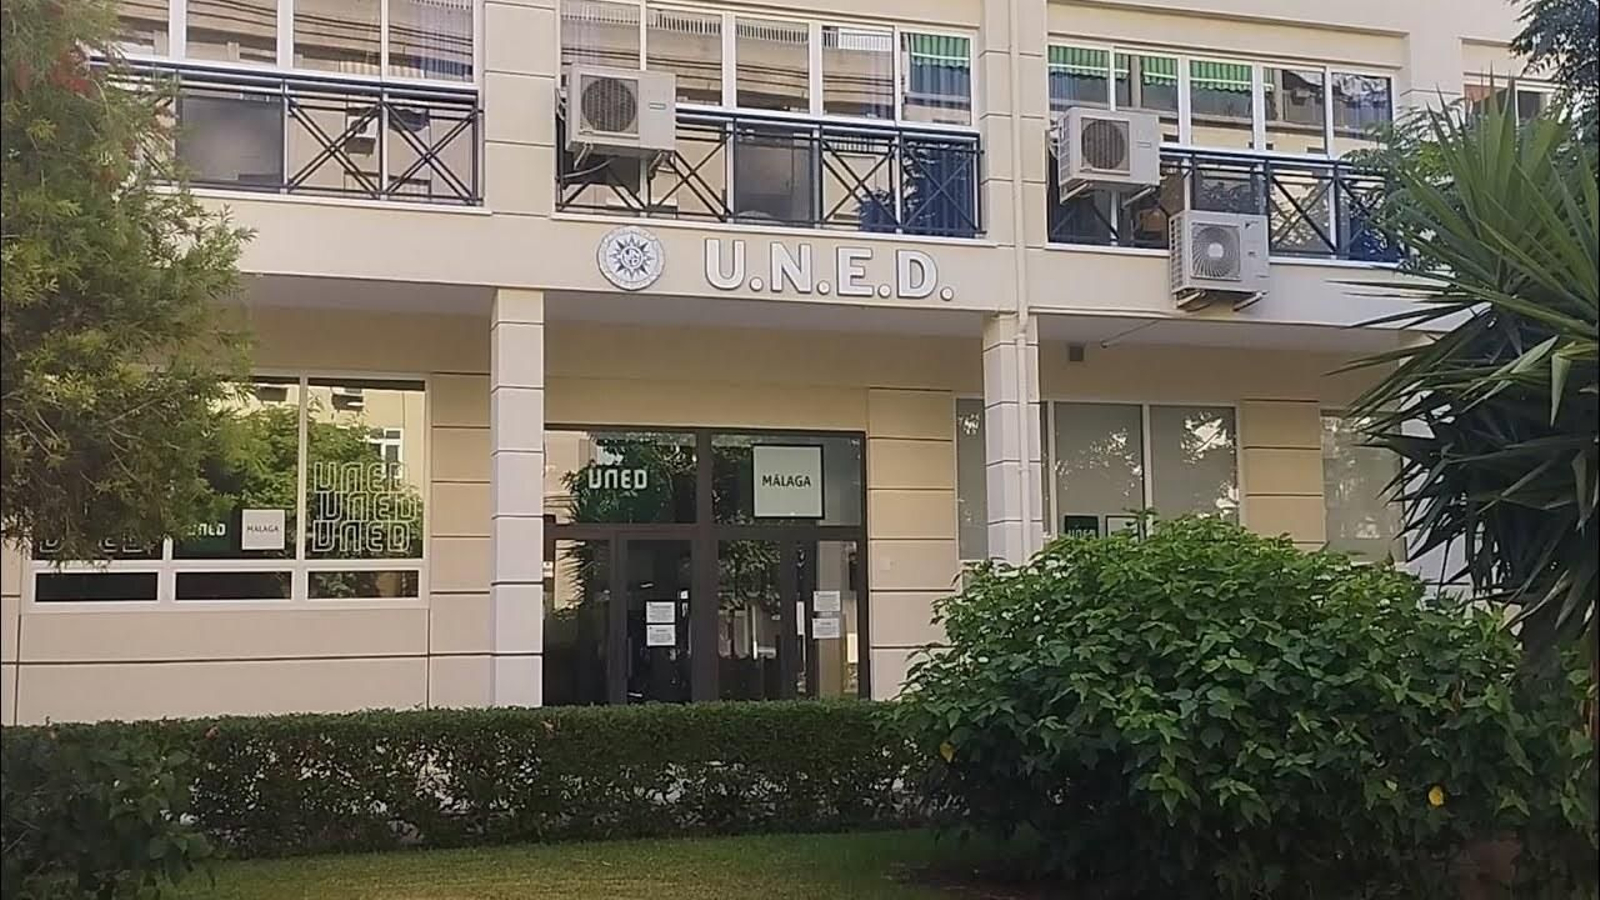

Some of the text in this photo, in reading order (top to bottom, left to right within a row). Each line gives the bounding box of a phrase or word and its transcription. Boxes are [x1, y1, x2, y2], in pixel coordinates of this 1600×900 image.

[704, 237, 955, 301] U.N.E.D.
[588, 468, 648, 489] UNED
[761, 473, 811, 487] MÁLAGA
[320, 491, 417, 522] UNED
[312, 520, 410, 552] UNED
